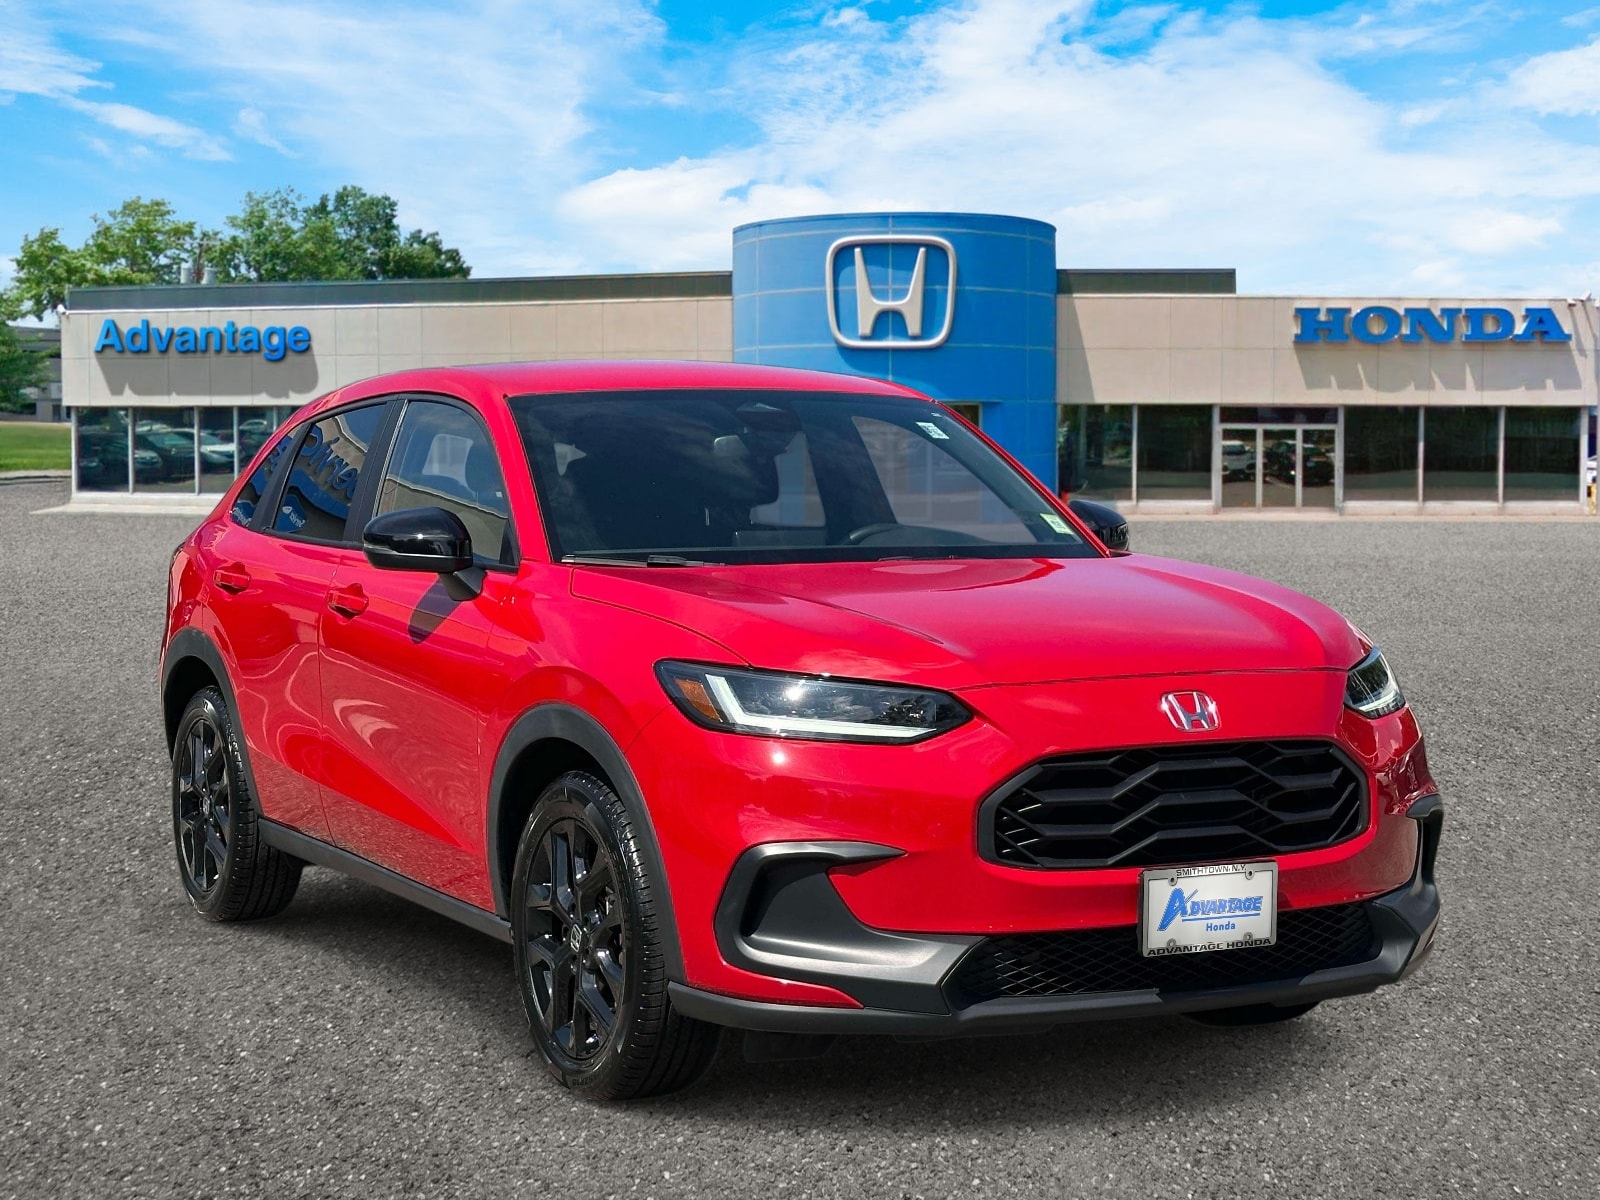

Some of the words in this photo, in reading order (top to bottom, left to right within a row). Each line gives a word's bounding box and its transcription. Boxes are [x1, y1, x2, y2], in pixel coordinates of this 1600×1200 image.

[94, 318, 312, 362] Advantage
[1293, 305, 1573, 344] HONDA
[1157, 887, 1263, 931] ADVANTAGE
[1206, 921, 1236, 932] Honda
[1147, 943, 1224, 956] ADVANTAGE
[1226, 938, 1272, 948] HONDA
